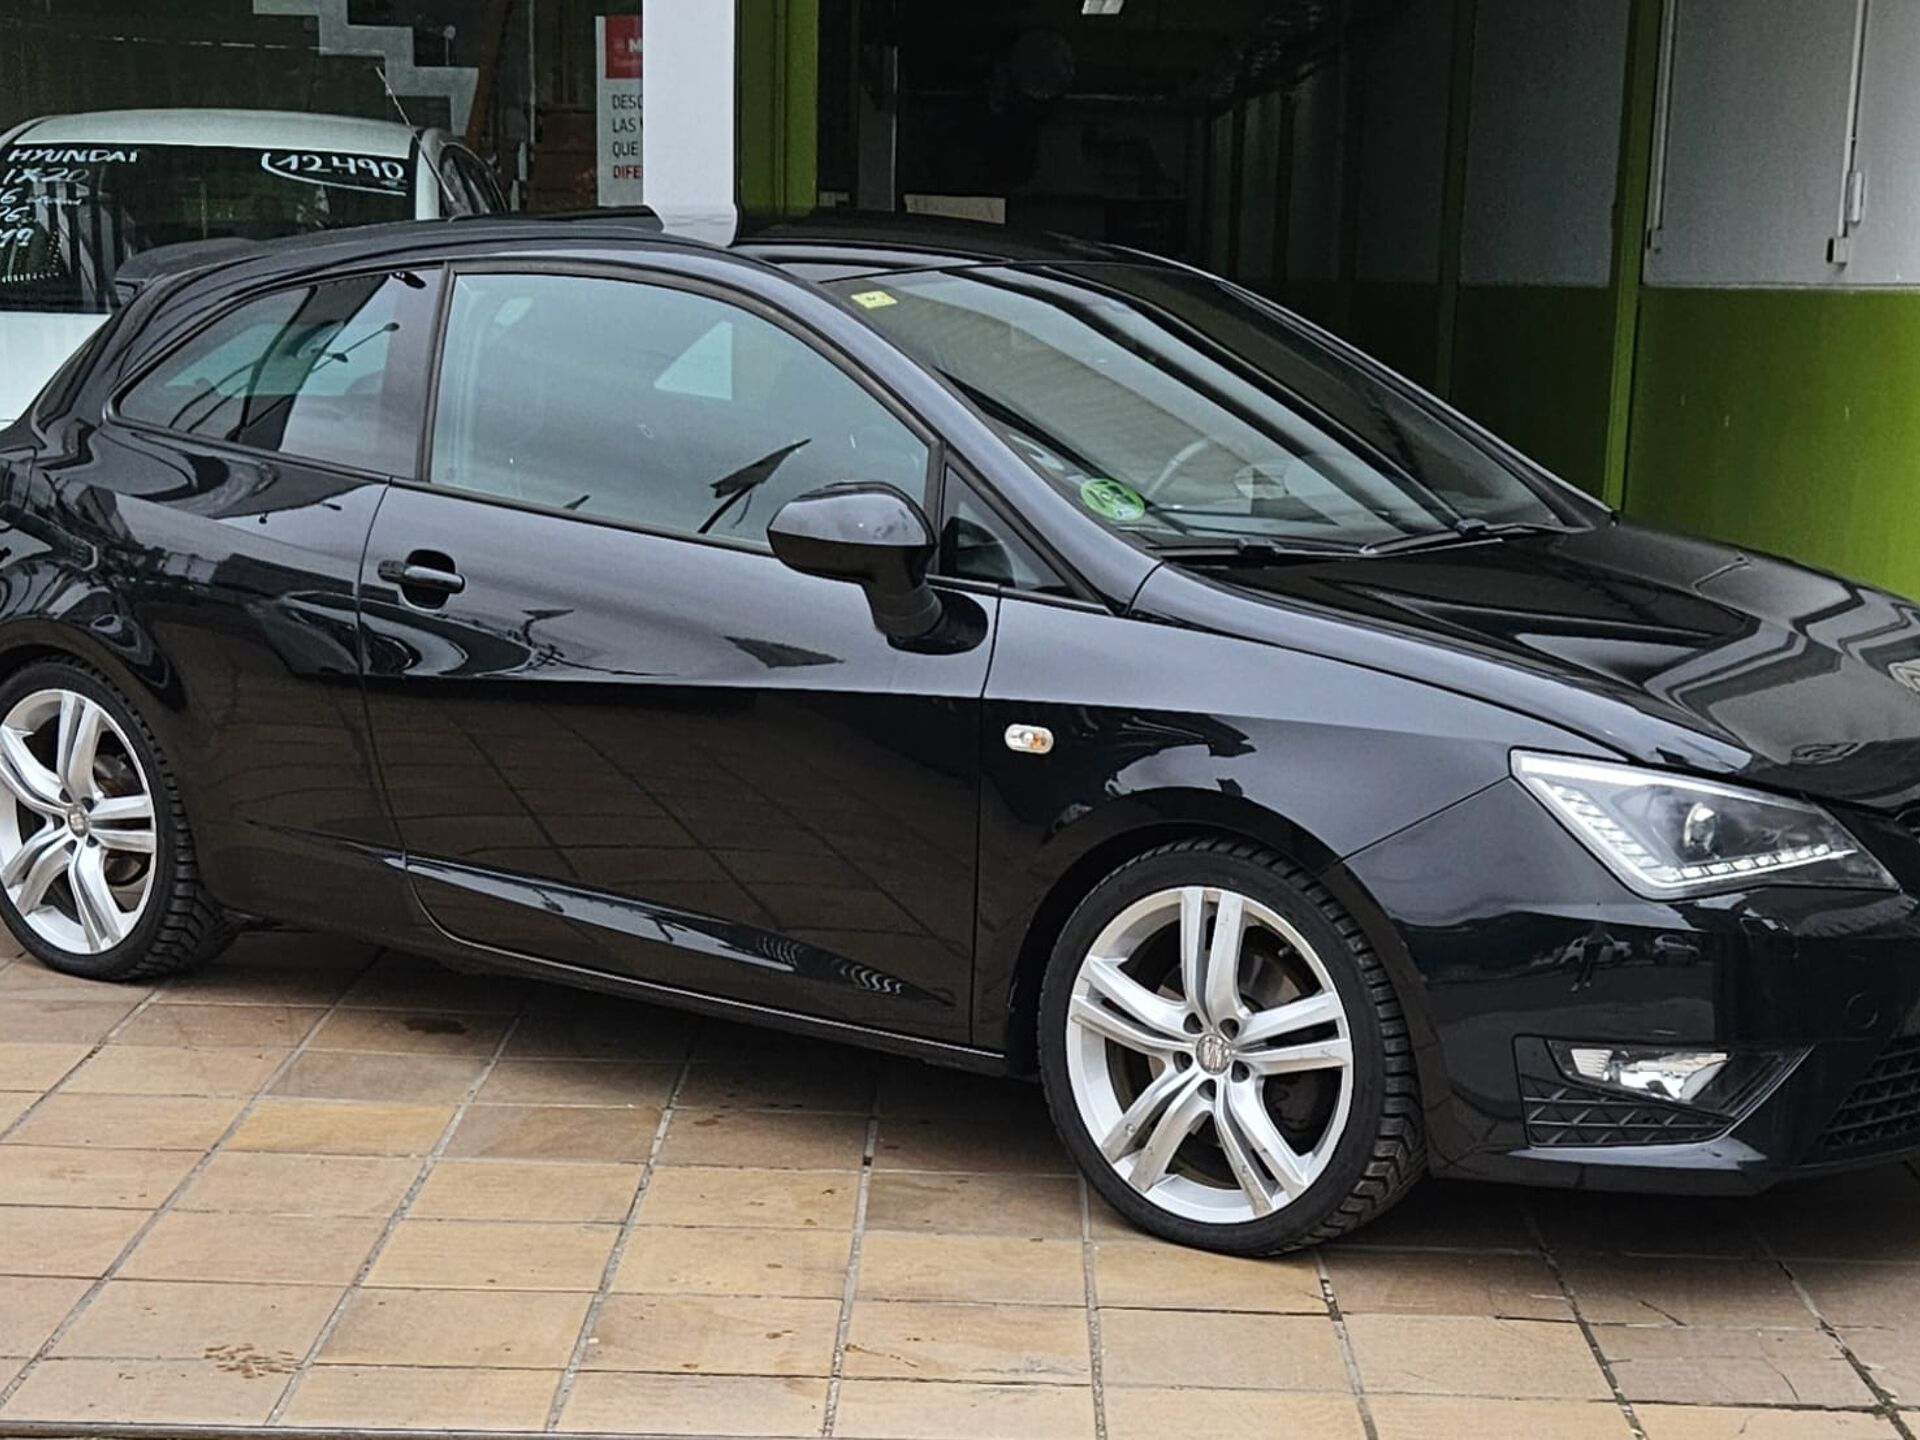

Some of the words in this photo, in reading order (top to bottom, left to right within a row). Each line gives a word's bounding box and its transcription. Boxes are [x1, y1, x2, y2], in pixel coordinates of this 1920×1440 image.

[612, 117, 637, 134] LAS
[7, 148, 138, 163] HYUNDAI
[612, 141, 639, 158] QUE
